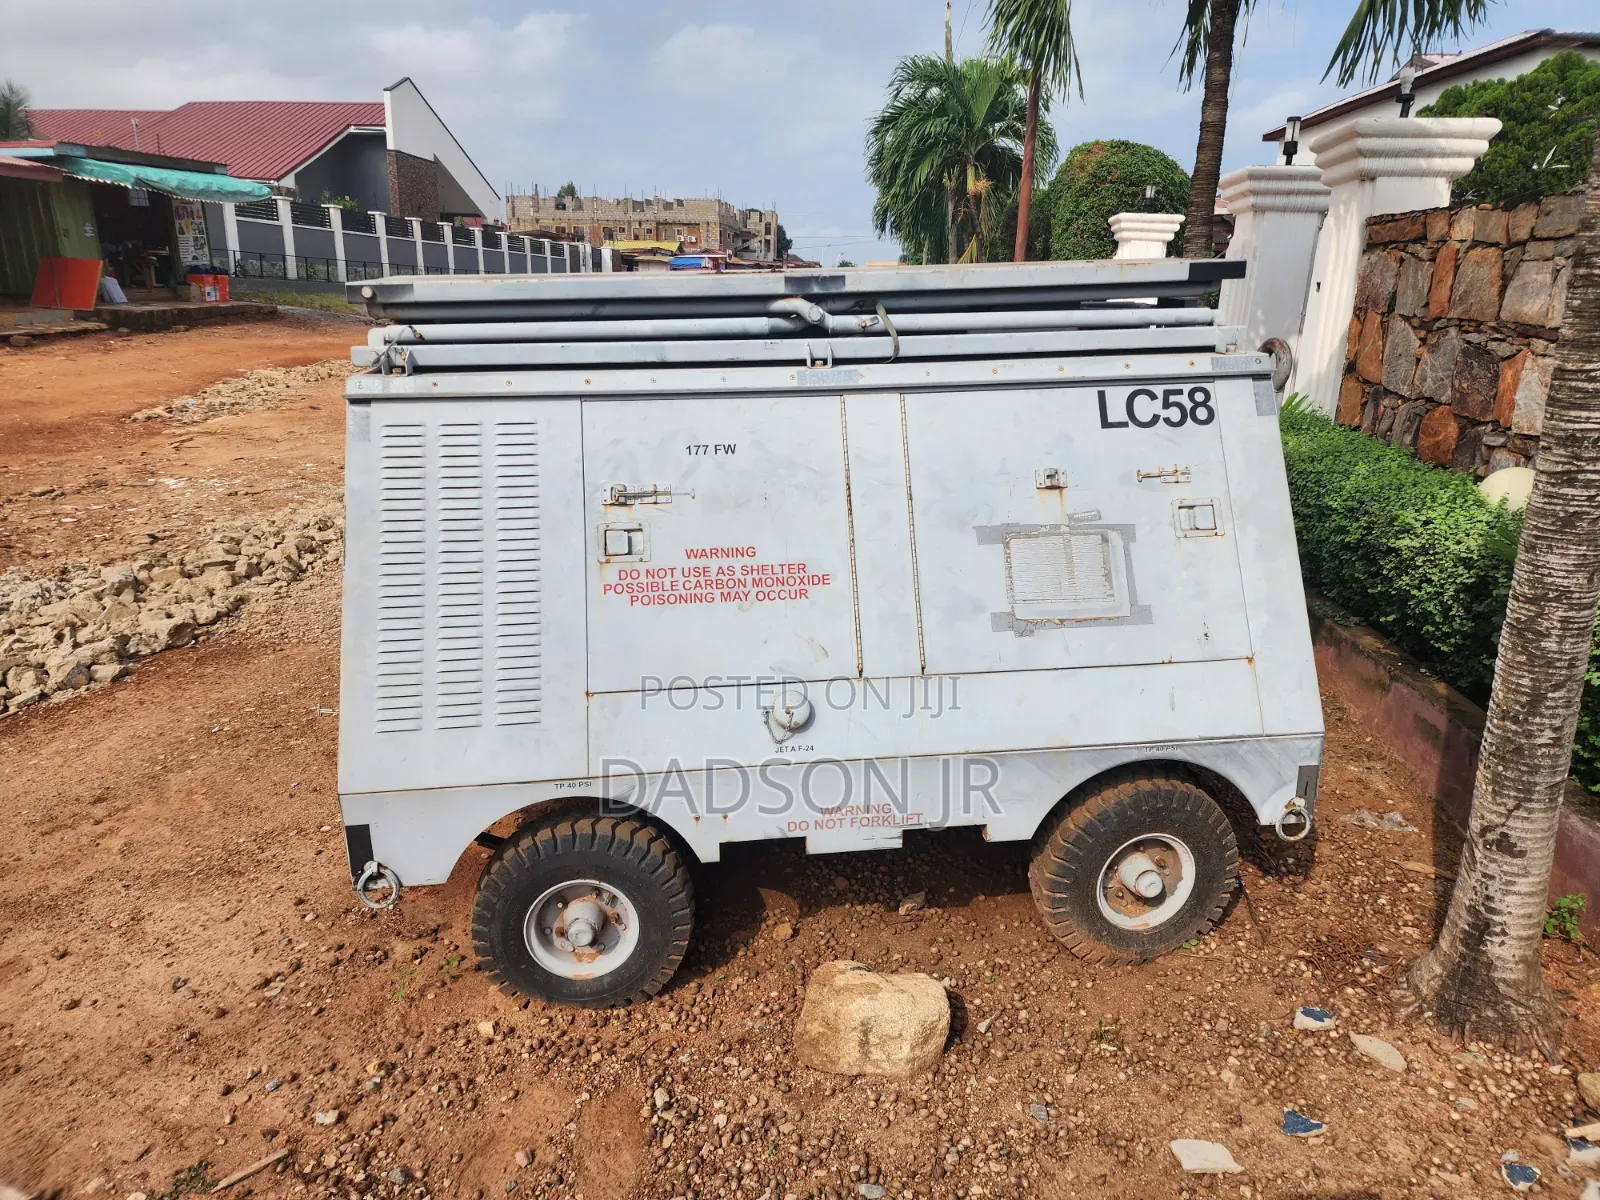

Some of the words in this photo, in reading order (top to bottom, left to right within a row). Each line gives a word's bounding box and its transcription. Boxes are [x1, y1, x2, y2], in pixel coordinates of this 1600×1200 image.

[1096, 386, 1215, 430] LC58
[685, 444, 709, 456] 177
[714, 443, 737, 455] FW
[685, 546, 756, 560] WARNING
[618, 569, 641, 581] DO
[645, 567, 676, 580] NOT
[681, 566, 711, 578] USE
[716, 566, 736, 577] AS
[740, 563, 807, 576] SHELTER
[603, 580, 679, 595] POSSIBLE
[682, 578, 747, 591] CARBON
[752, 574, 831, 589] MONOXIDE
[630, 592, 715, 606] POISONING
[720, 591, 751, 603] MAY
[755, 588, 808, 602] OCCUR
[820, 803, 892, 818] WARNING
[787, 820, 810, 832] DO
[814, 818, 847, 831] NOT
[850, 813, 923, 829] FORKLIFT
